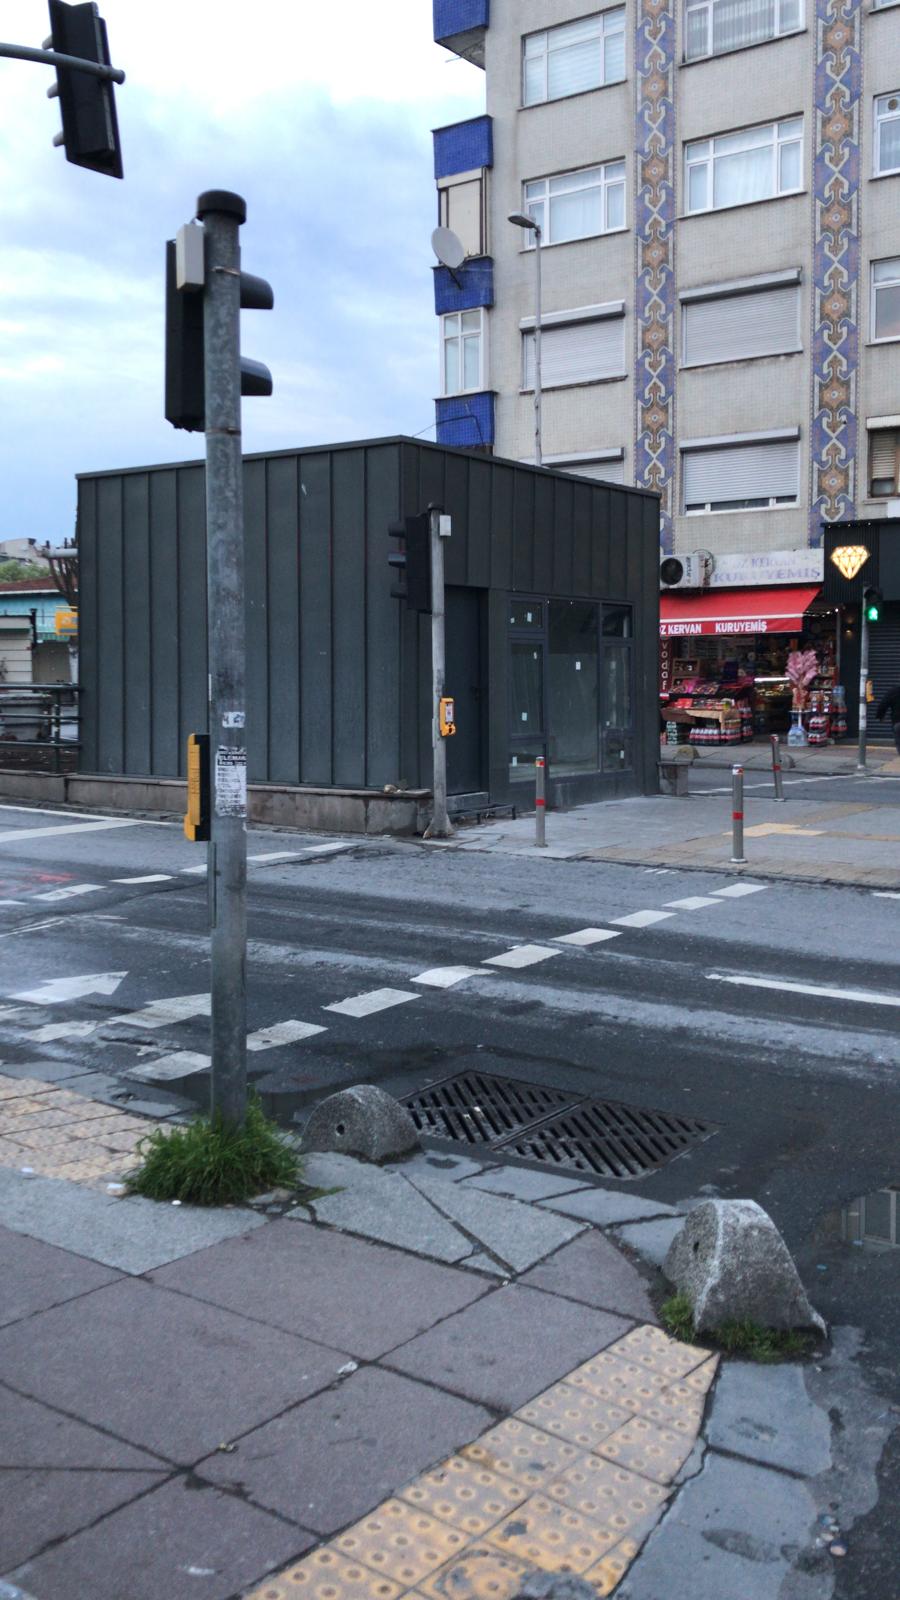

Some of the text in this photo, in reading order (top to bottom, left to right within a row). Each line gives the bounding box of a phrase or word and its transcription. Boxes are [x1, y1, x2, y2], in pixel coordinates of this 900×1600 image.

[659, 620, 767, 635] Z KERVAN KURUYEMİŞ
